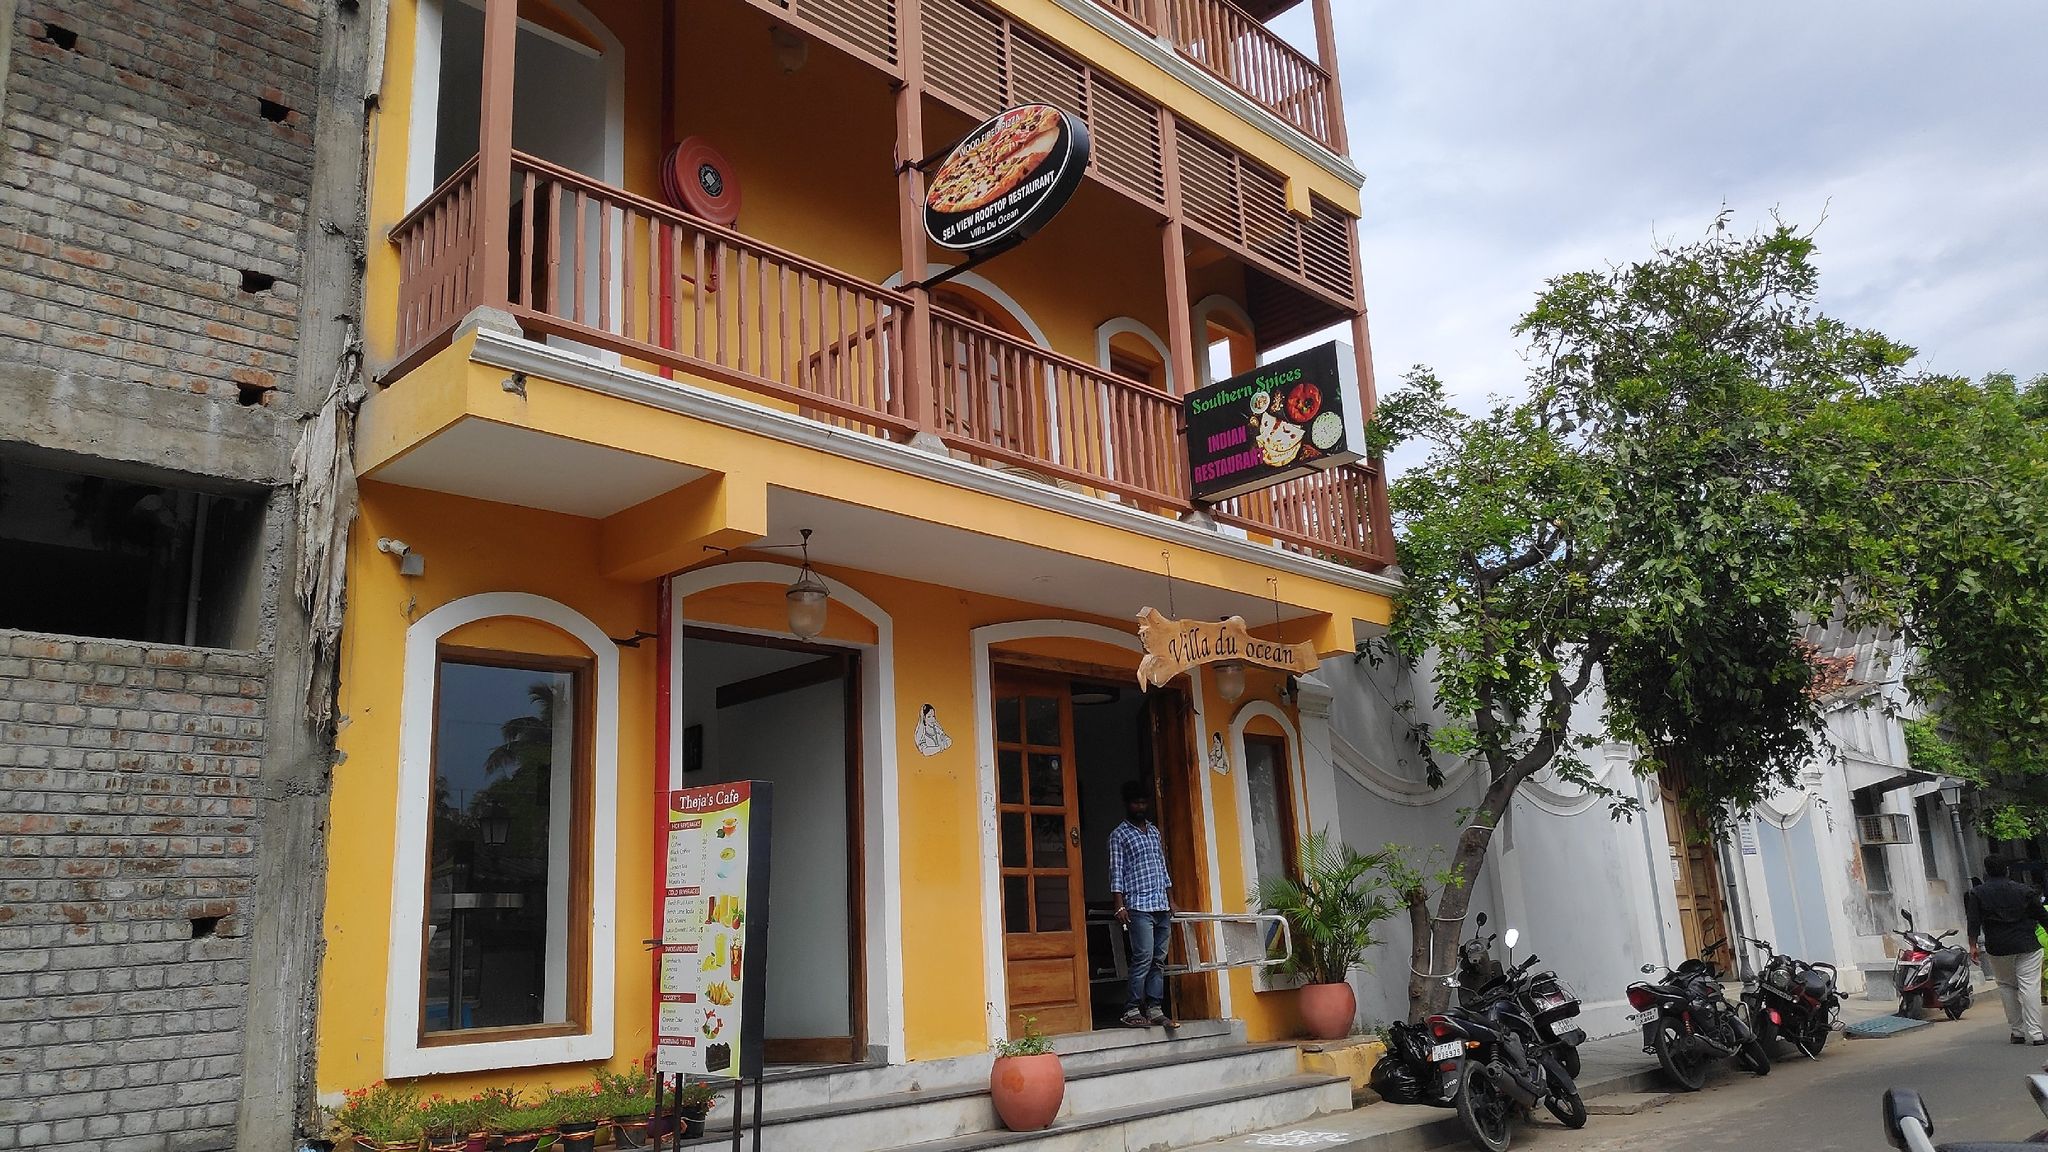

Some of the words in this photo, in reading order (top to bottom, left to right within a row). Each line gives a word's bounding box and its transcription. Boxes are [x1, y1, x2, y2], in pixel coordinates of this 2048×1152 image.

[958, 138, 981, 157] WOOD
[942, 226, 956, 241] SEA
[956, 214, 975, 233] VIEW
[974, 198, 1007, 224] ROOFTOP
[1008, 170, 1055, 206] RESTAURANT
[969, 227, 986, 239] Villa
[986, 220, 997, 231] Du
[998, 207, 1019, 225] Ocean
[1191, 384, 1252, 415] Southern
[1254, 367, 1302, 395] Spices
[1207, 425, 1247, 454] INDIAN
[1194, 447, 1264, 484] RESTAURANT
[1168, 627, 1211, 664] Villa
[1215, 626, 1238, 656] du
[1245, 642, 1295, 664] ocean
[680, 793, 714, 811] Theja's
[716, 789, 740, 805] Cafe
